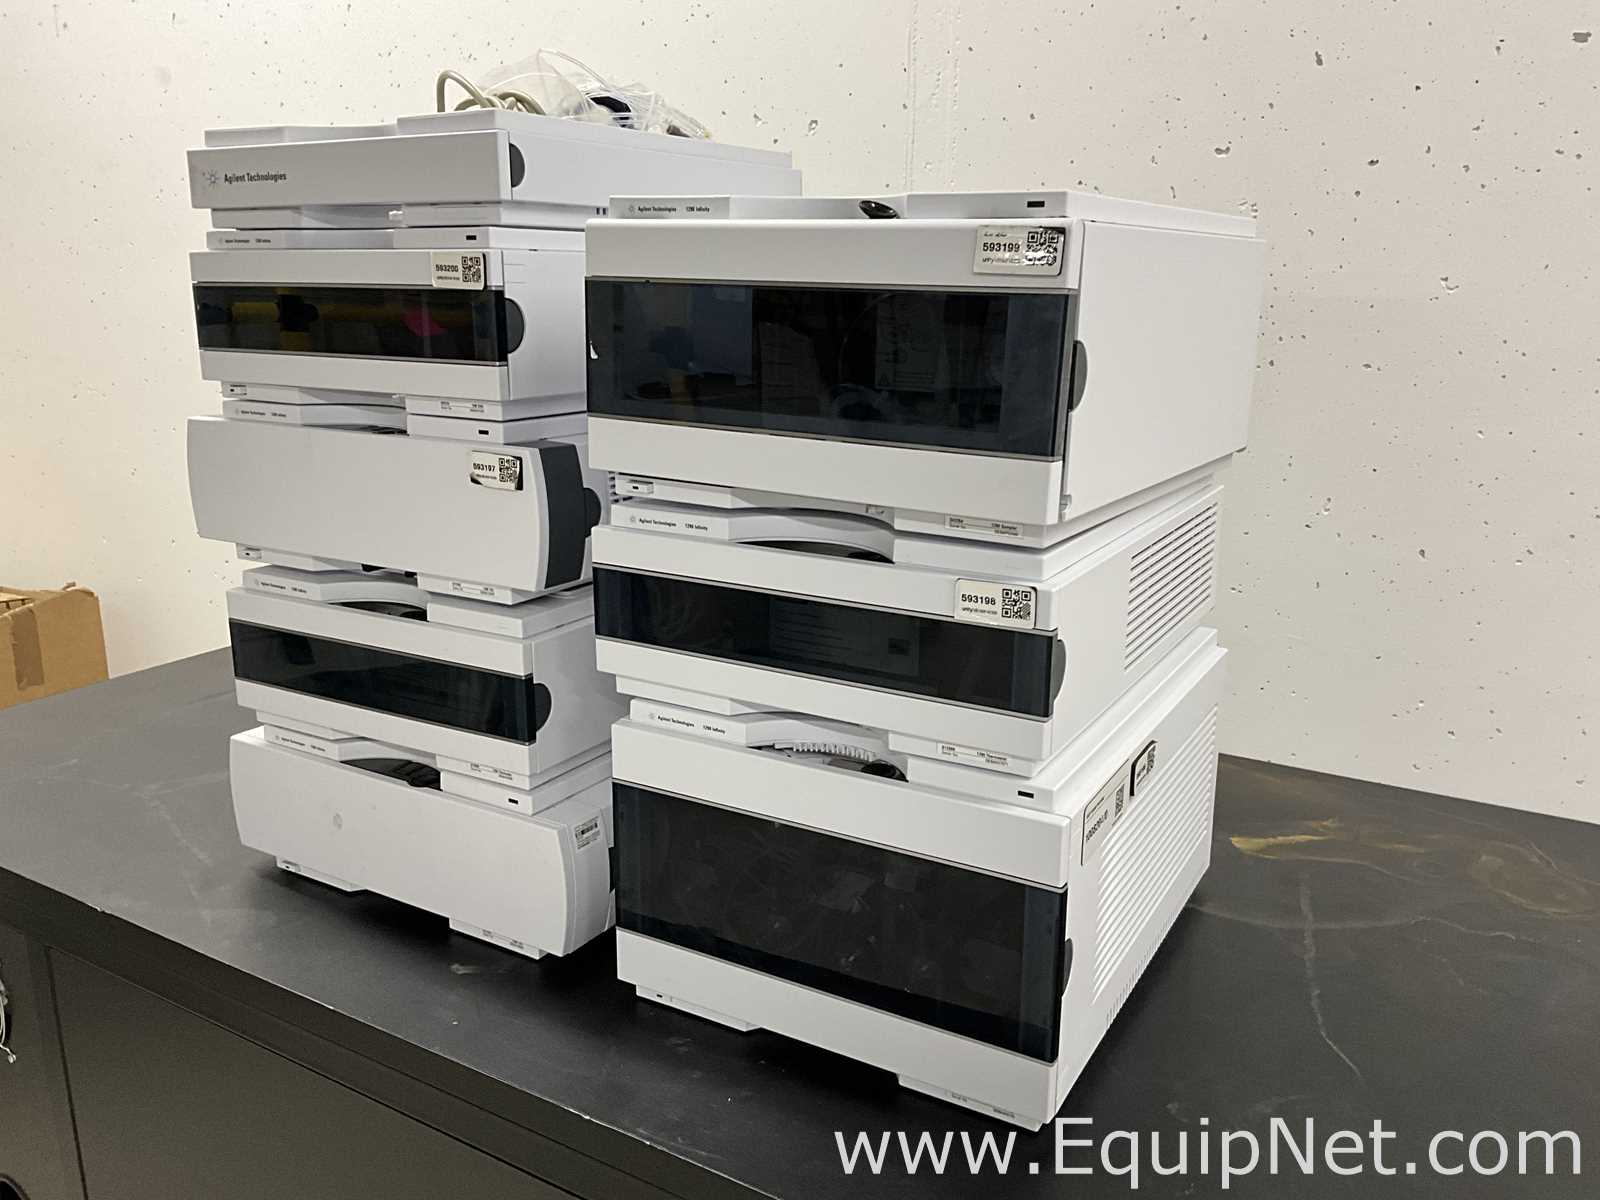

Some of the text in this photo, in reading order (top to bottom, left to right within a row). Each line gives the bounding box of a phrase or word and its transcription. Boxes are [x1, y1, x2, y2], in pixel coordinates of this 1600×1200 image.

[224, 172, 287, 184] Agilent Technologies
[982, 242, 1020, 253] 593199
[961, 594, 996, 606] 593198
